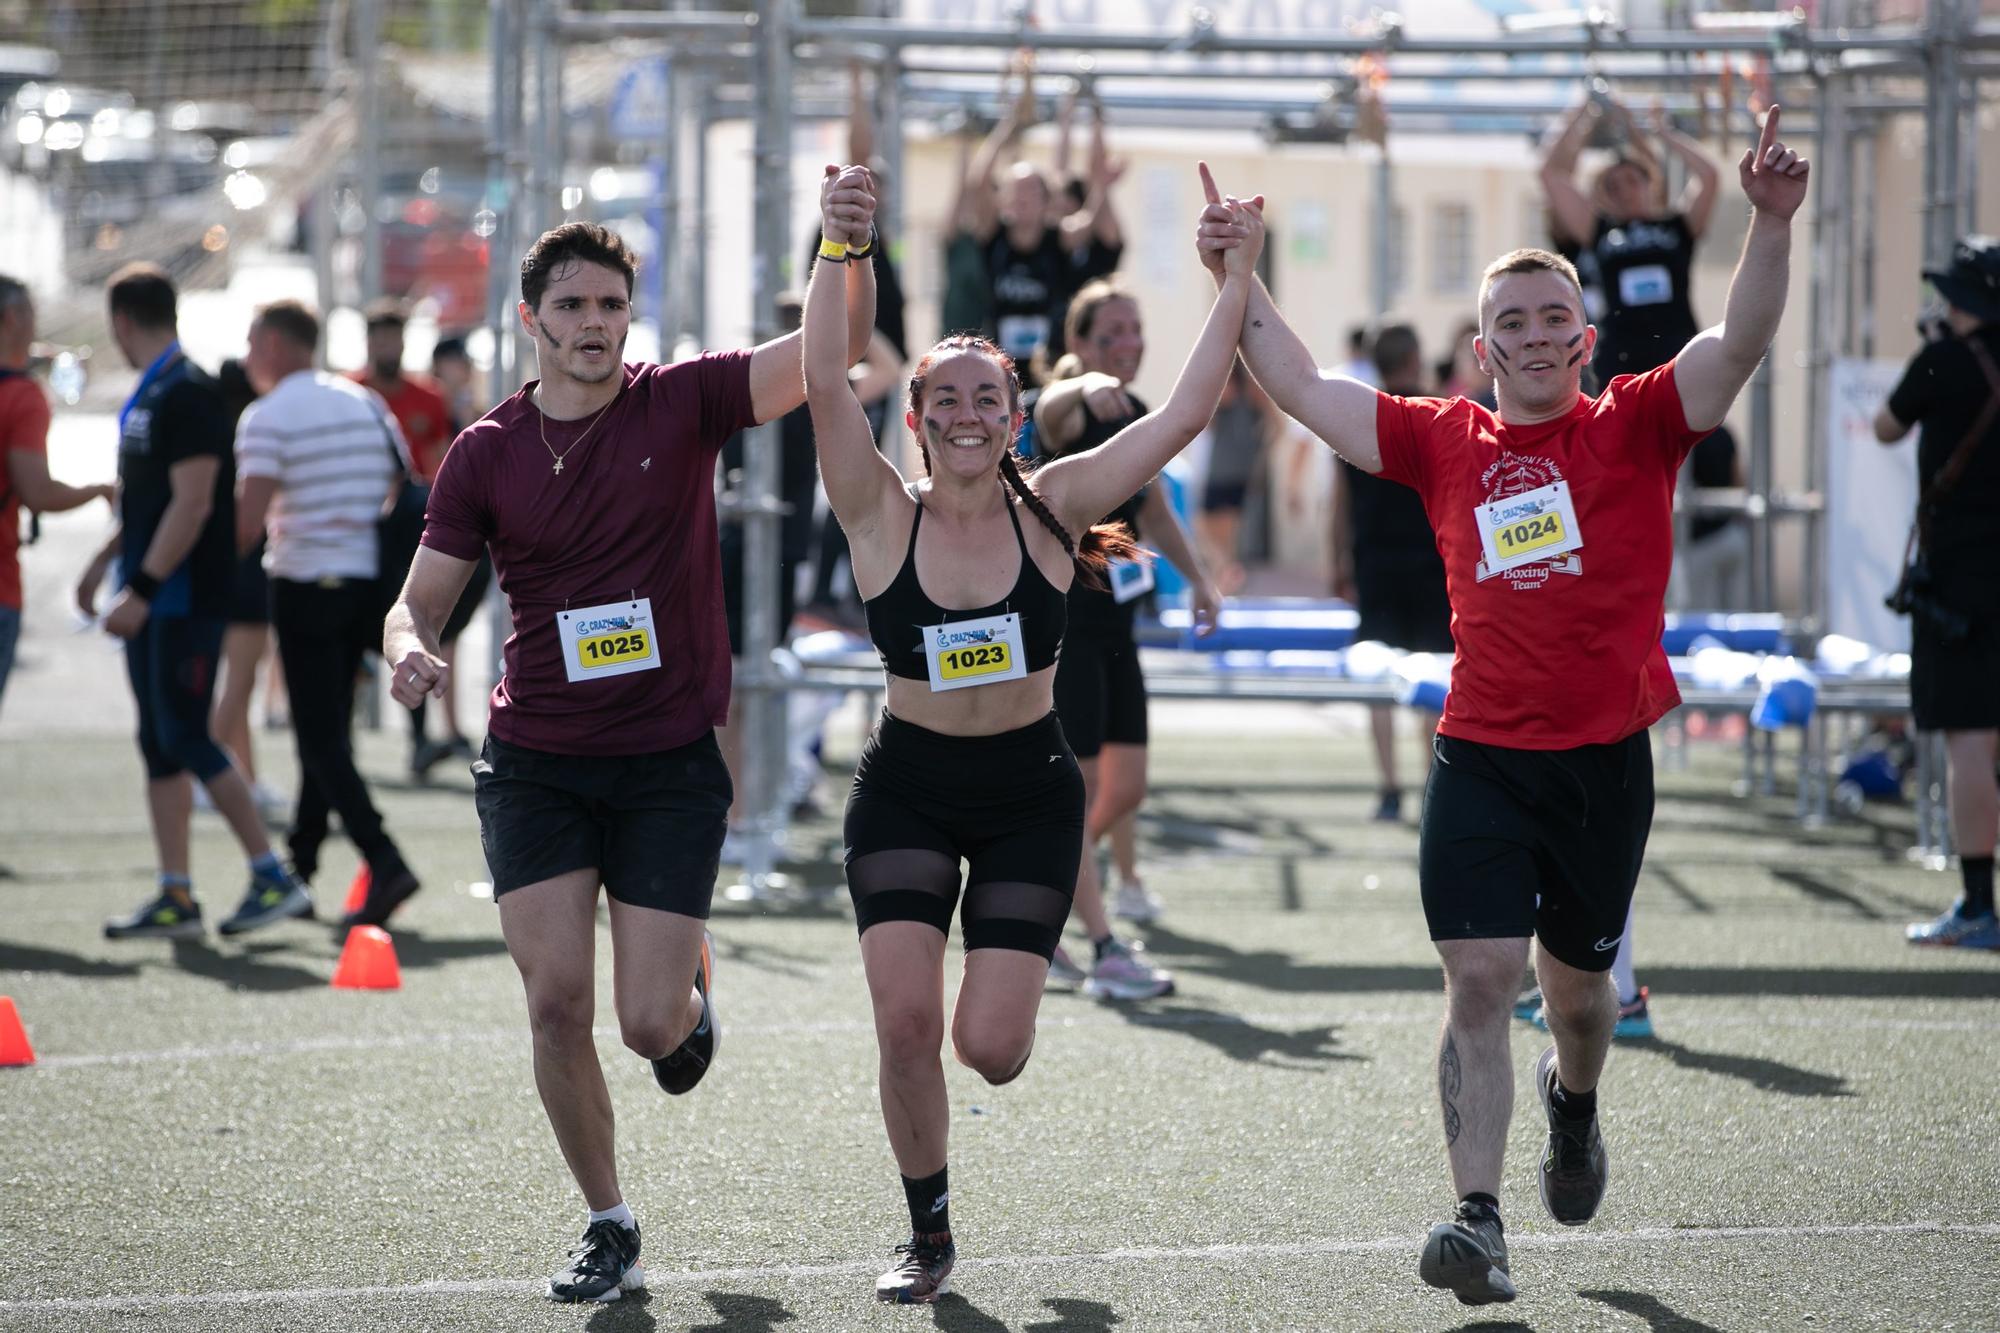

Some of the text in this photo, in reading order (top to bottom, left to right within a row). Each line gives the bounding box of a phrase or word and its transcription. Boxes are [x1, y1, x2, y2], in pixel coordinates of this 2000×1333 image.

[1502, 516, 1557, 547] 1024
[1503, 566, 1549, 582] Boxing
[1511, 581, 1542, 590] Team
[586, 633, 644, 659] 1025
[946, 646, 1005, 670] 1023
